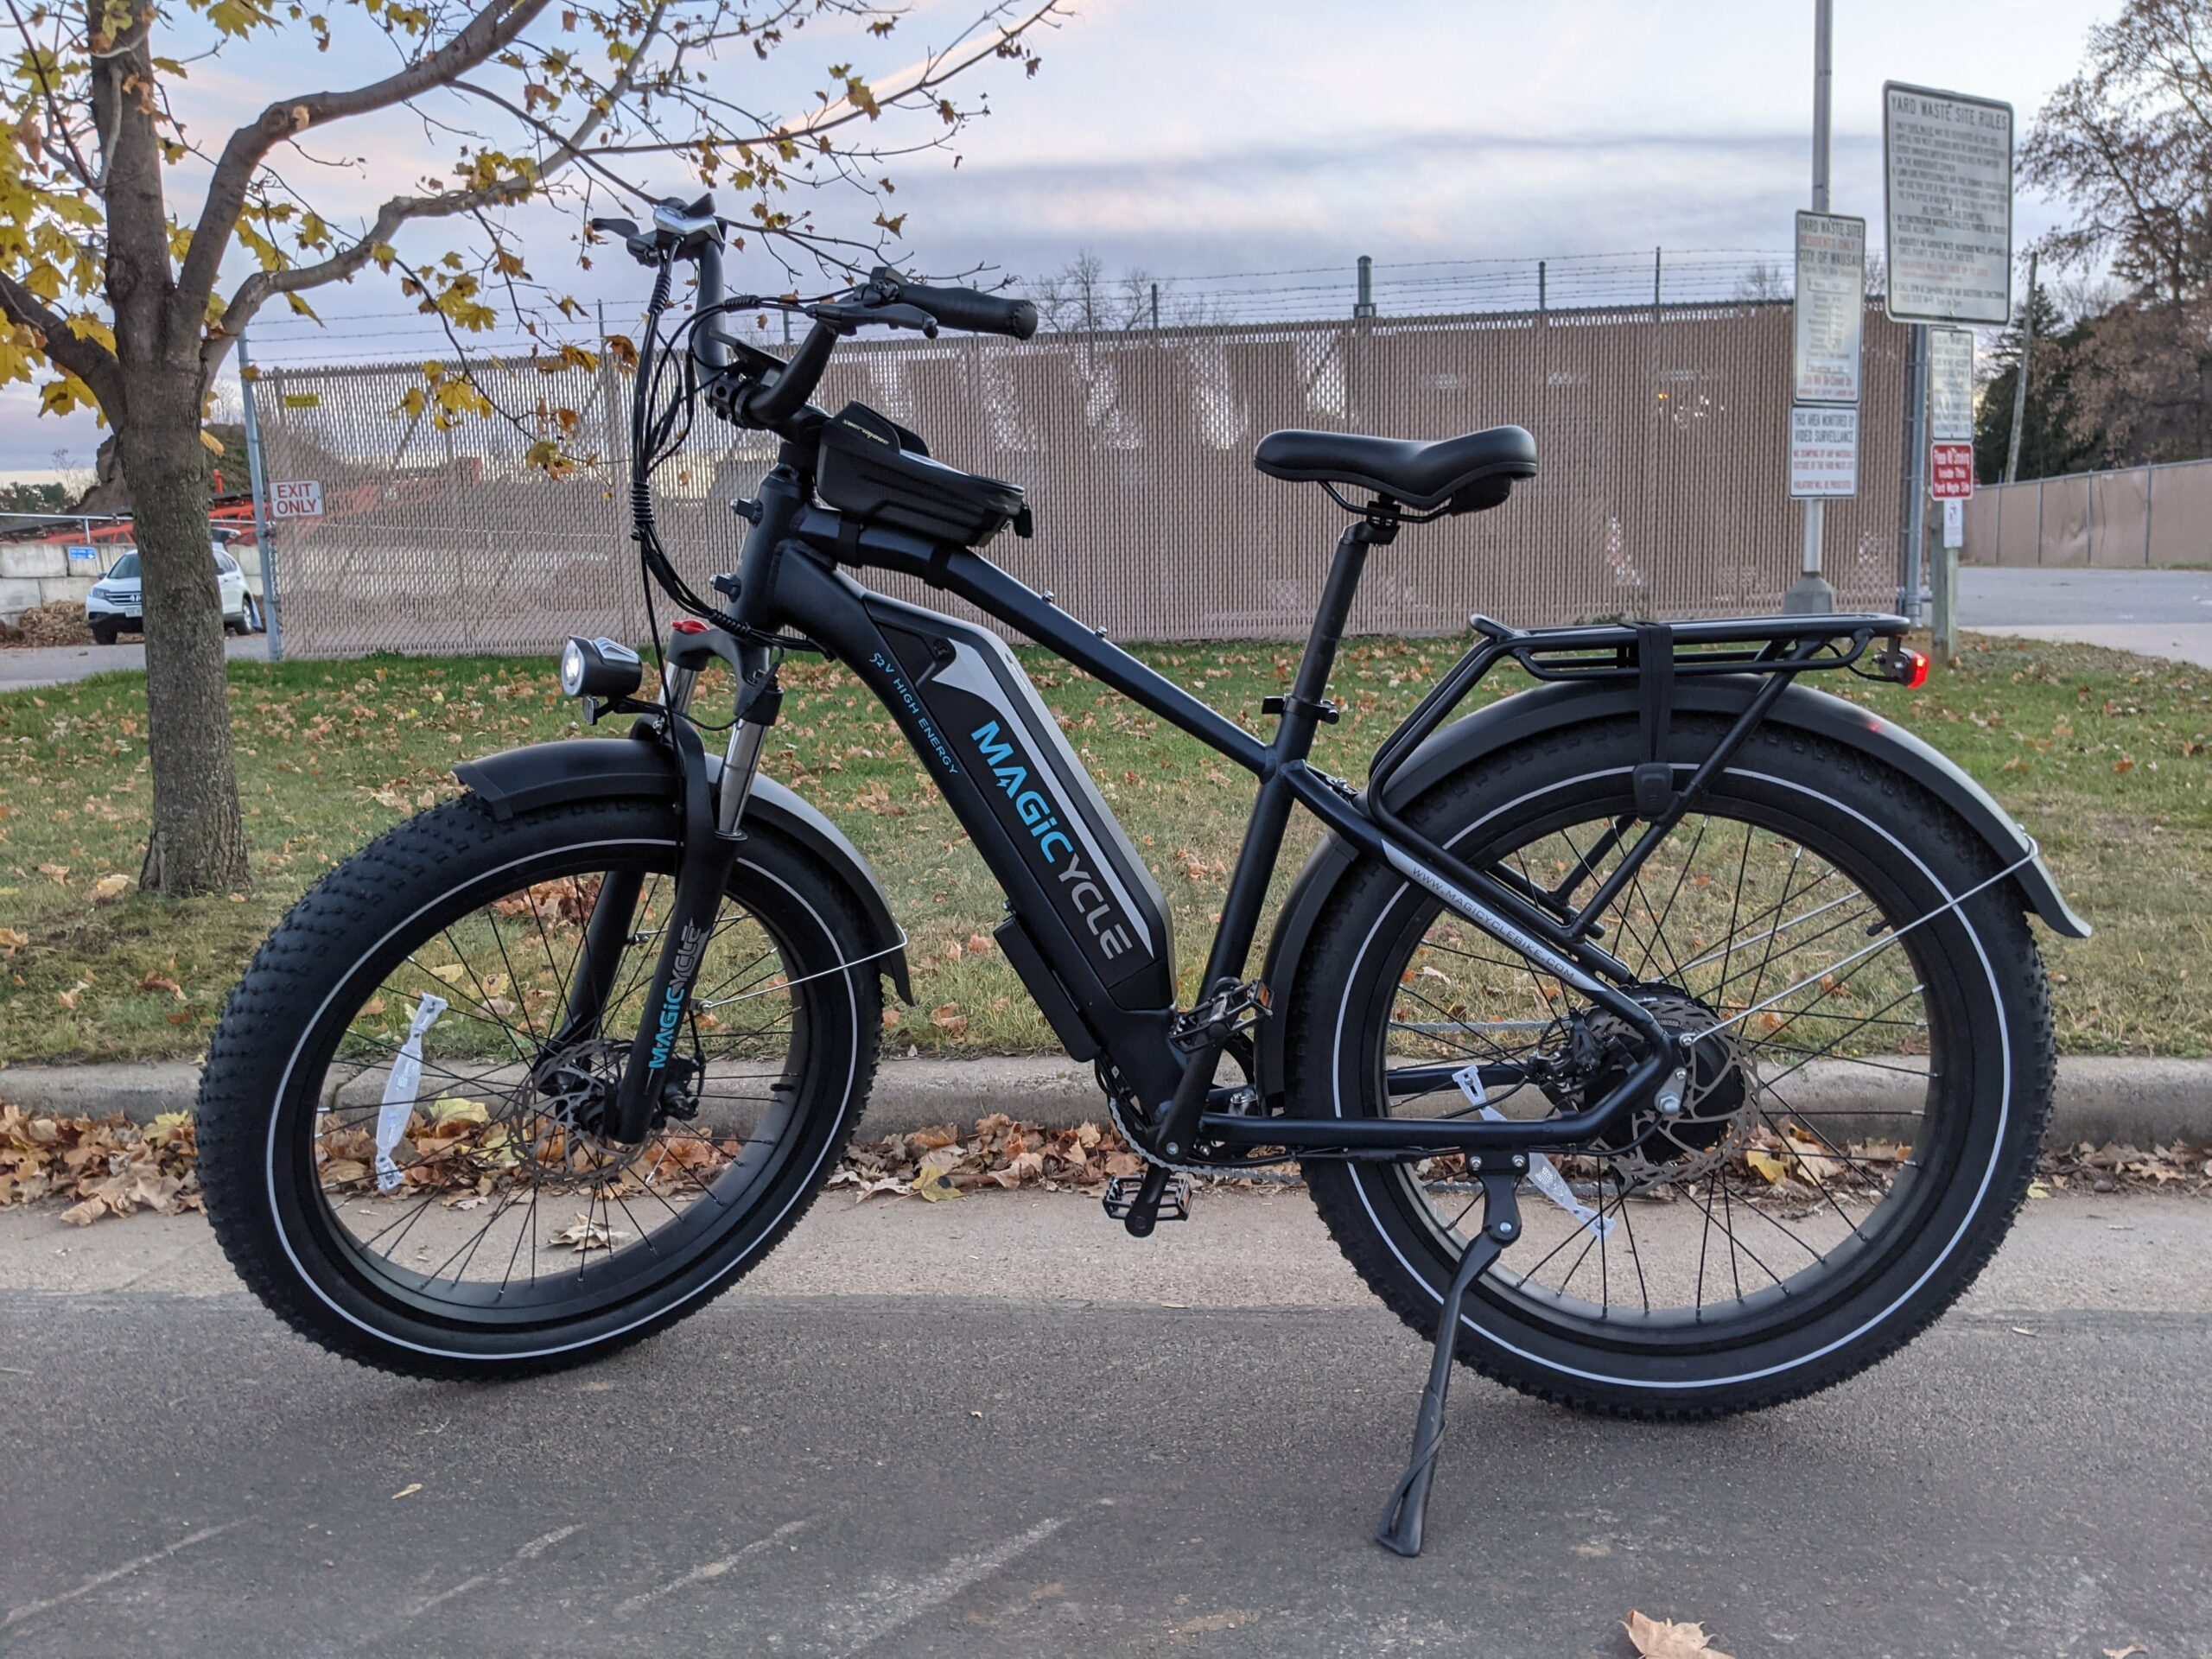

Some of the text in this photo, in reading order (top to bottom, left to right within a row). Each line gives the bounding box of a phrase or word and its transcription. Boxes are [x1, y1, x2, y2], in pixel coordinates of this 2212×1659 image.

[1891, 95, 2007, 131] YARD WASTE SITE RULES
[1798, 219, 1862, 238] YARD WASTE SITE
[1798, 248, 1815, 263] CITY
[1817, 251, 1828, 264] OF
[1794, 413, 1806, 426] THIS
[1808, 414, 1820, 427] AREA
[1795, 429, 1853, 443] VIDEO SURVEILLANCE
[276, 483, 312, 499] EXIT
[276, 499, 316, 515] ONLY
[869, 652, 959, 776] 52V HIGH ENERGY
[1412, 866, 1576, 980] WWW.MAGICYCLEBIKE.COM
